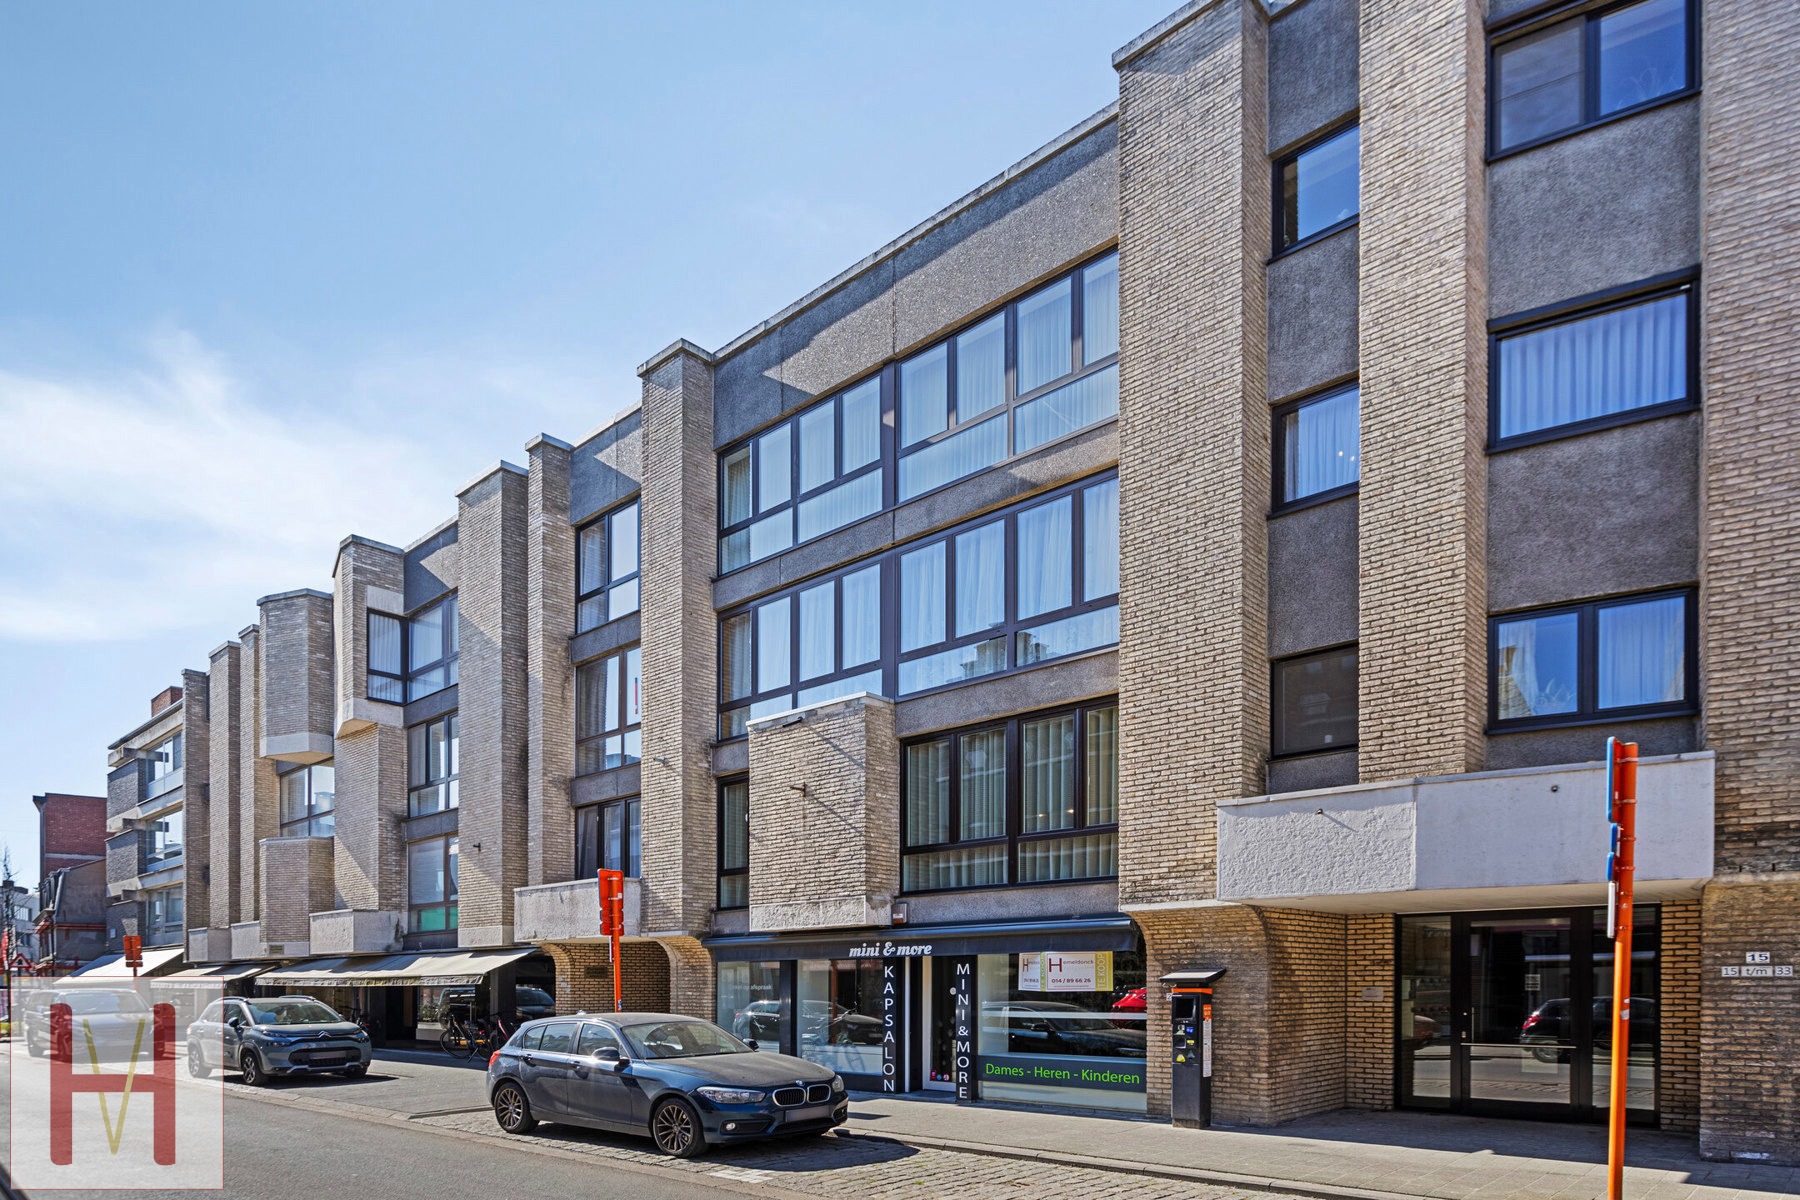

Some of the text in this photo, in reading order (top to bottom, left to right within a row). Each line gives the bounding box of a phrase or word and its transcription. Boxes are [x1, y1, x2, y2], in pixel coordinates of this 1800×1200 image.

[849, 941, 932, 957] mini & more
[1097, 954, 1105, 977] KOOP
[1724, 967, 1791, 976] 15 t/m 33
[882, 965, 895, 1092] KAPSALON
[985, 1063, 1024, 1077] Dames
[1034, 1066, 1070, 1080] Heren
[1081, 1069, 1140, 1084] Kinderen
